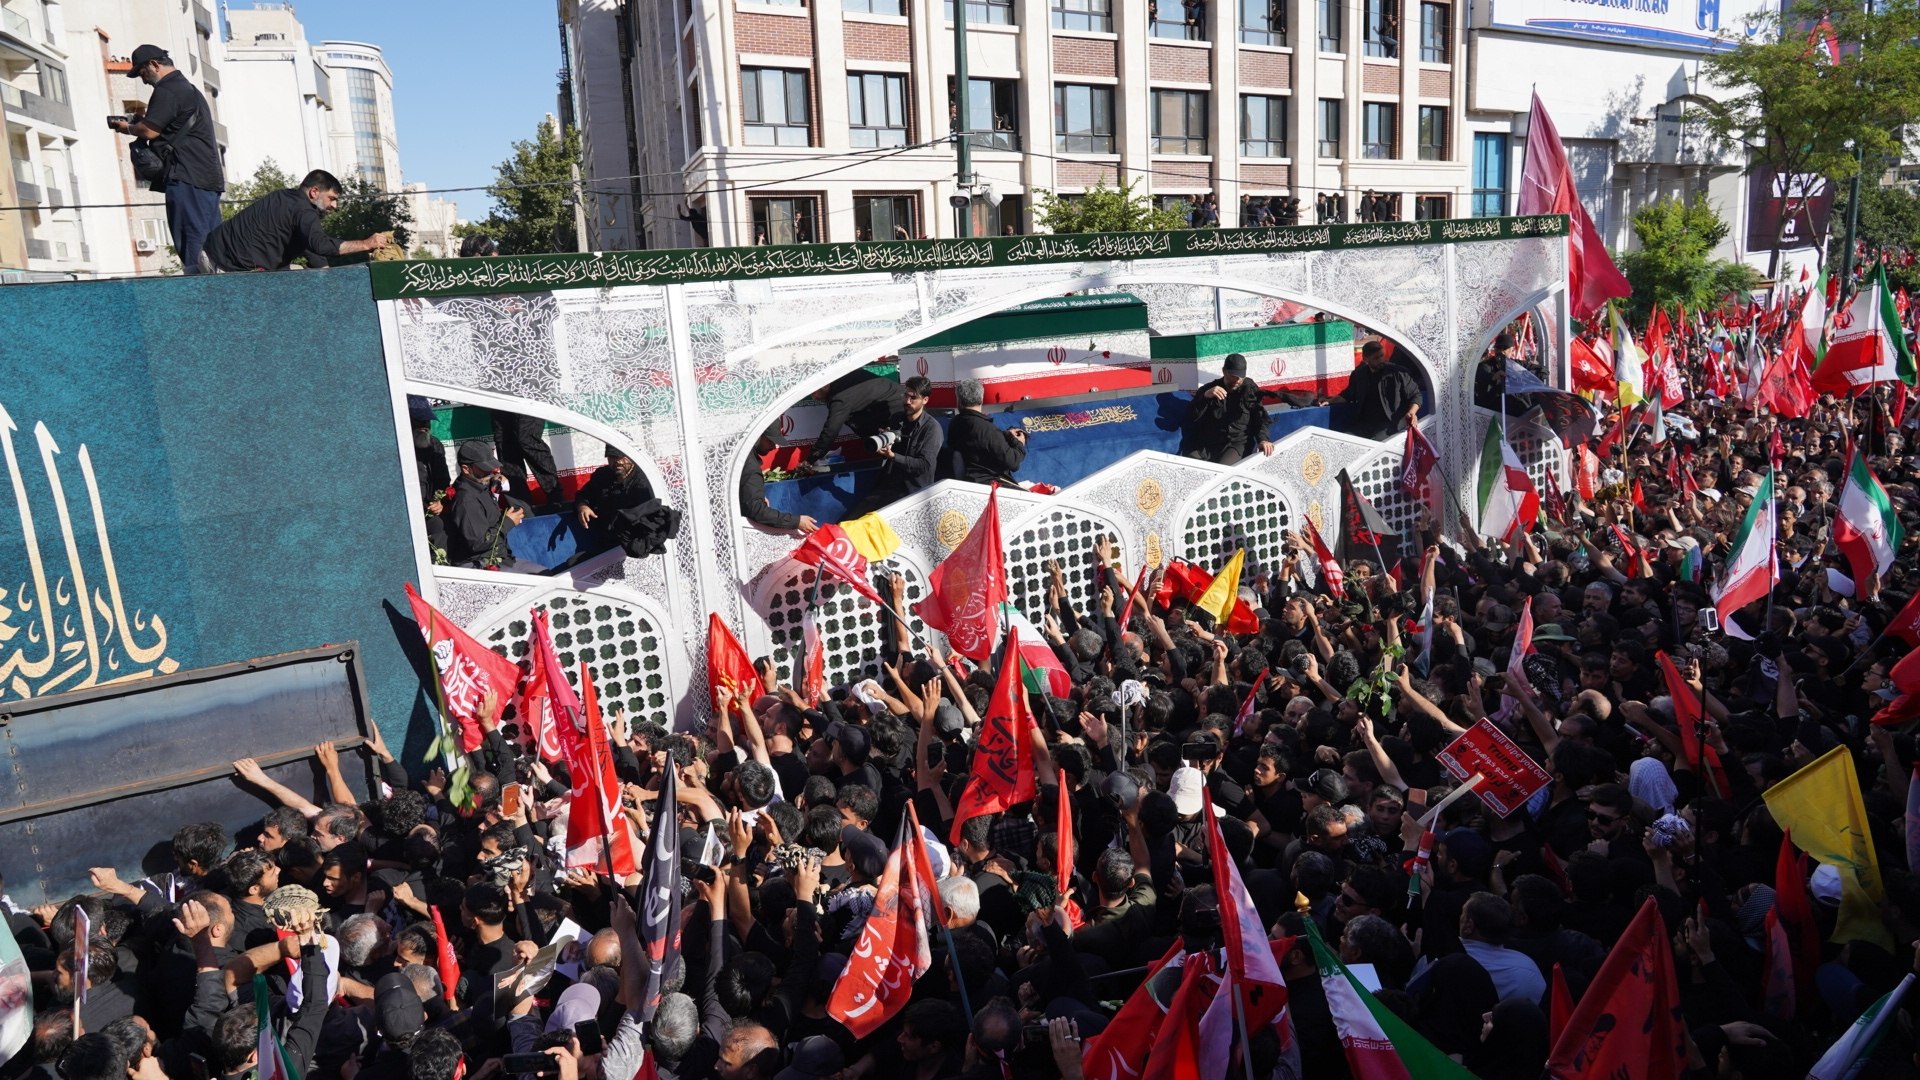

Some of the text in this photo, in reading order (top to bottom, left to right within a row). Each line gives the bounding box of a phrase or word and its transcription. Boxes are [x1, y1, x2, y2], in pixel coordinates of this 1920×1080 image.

[1492, 731, 1507, 744] will
[1504, 743, 1521, 759] wipe
[1520, 757, 1535, 770] you
